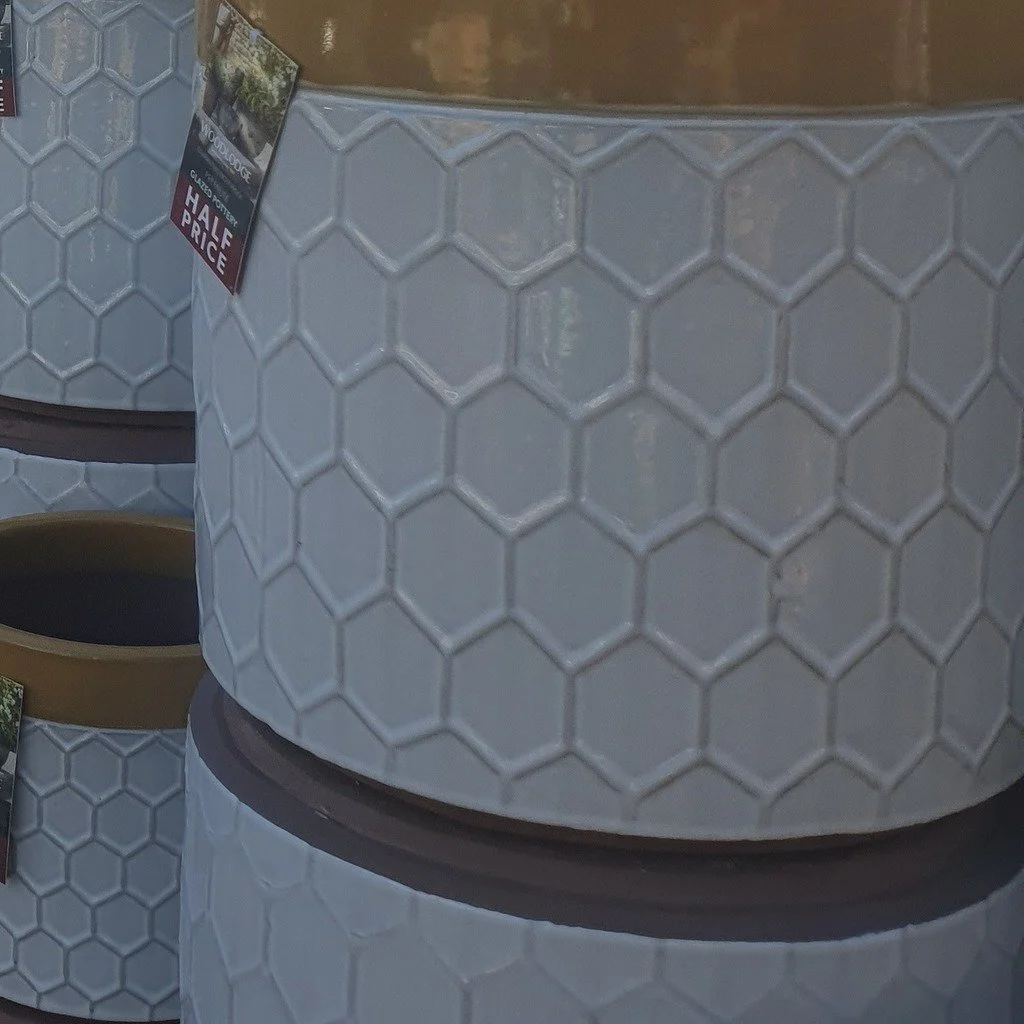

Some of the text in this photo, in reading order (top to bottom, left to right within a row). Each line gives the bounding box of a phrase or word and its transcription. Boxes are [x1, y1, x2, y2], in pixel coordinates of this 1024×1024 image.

[200, 120, 252, 184] WOODLODGE
[185, 184, 233, 249] HALF
[190, 169, 212, 198] GLAZED
[212, 195, 238, 227] POTTERY
[181, 208, 227, 275] PRICE
